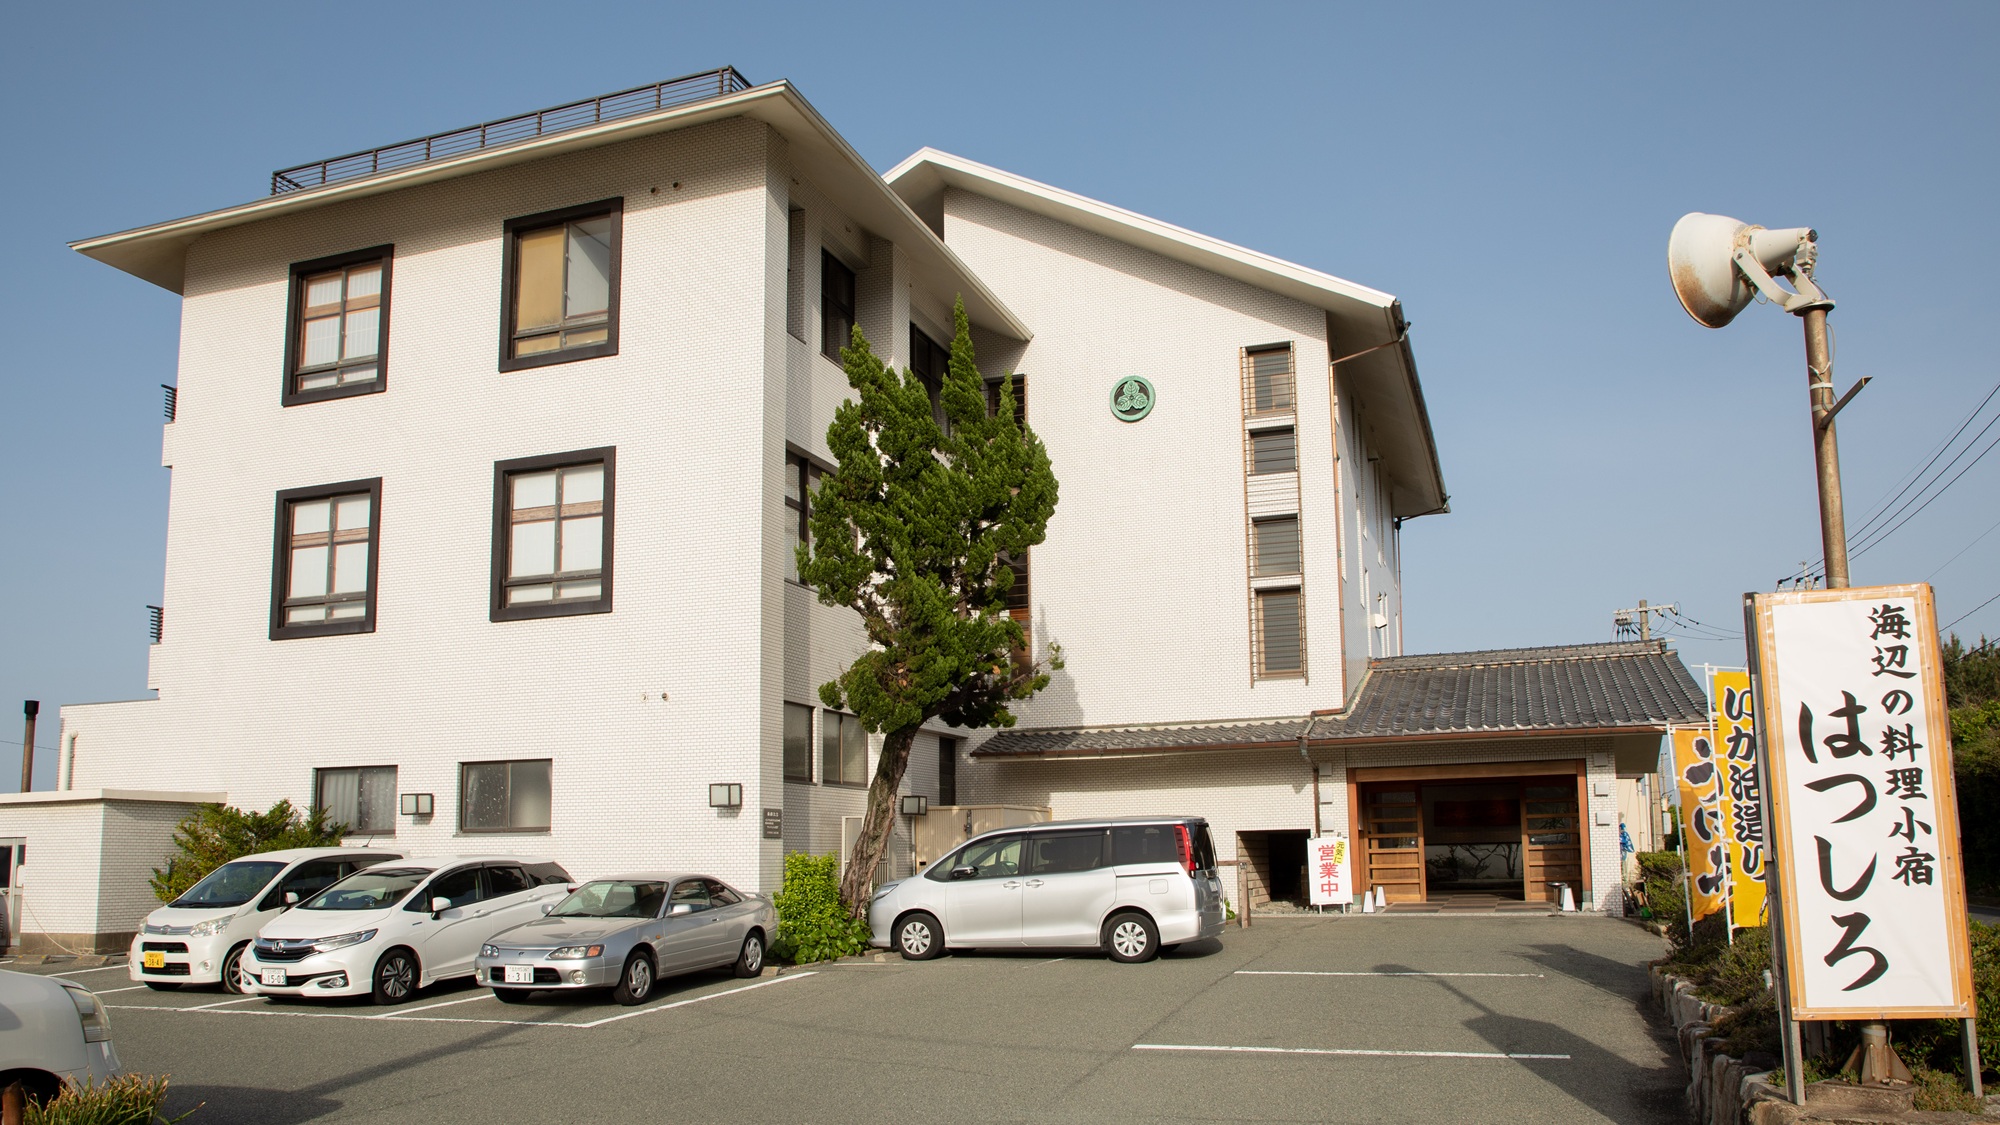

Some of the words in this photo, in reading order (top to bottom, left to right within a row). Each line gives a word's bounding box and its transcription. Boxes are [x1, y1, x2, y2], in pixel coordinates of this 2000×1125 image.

[1318, 844, 1339, 897] 営業中
[1798, 690, 1889, 991] はつしろ
[1868, 604, 1935, 887] 海辺の料理小宿
